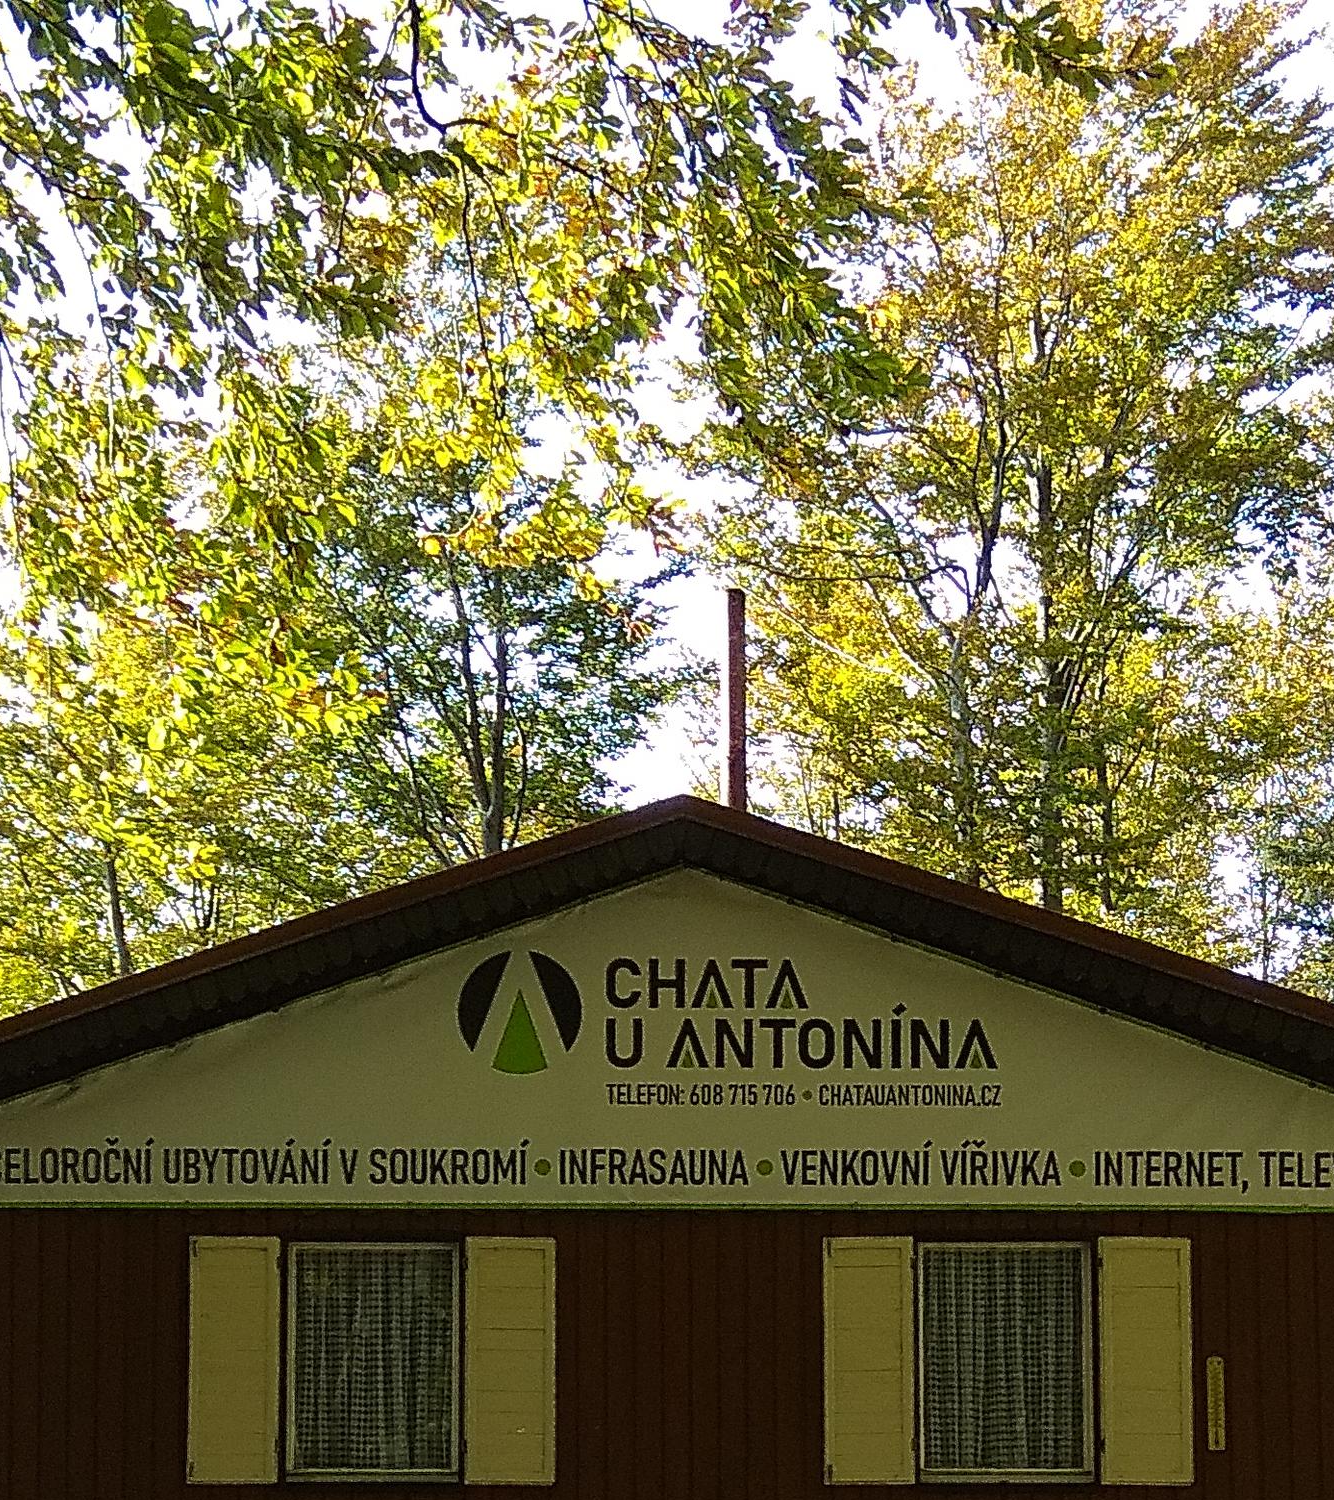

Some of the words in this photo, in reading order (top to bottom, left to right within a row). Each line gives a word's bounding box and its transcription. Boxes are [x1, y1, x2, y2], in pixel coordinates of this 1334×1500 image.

[604, 957, 809, 1010] CHATA
[604, 1017, 644, 1069] U
[665, 1002, 999, 1070] ANTONÍNA
[606, 1083, 685, 1106] TELEFON:
[689, 1083, 723, 1106] 608
[728, 1083, 758, 1106] 715
[763, 1083, 796, 1106] 706
[818, 1083, 1003, 1107] CHATAUANTONINA.CZ
[163, 1138, 333, 1185] UBYTOVÁNÍ
[339, 1148, 359, 1185] V
[368, 1138, 531, 1185] SOUKROMÍ
[558, 1147, 749, 1186] INFRASAUNA
[780, 1139, 934, 1187] VENKOVNÍ
[940, 1139, 1063, 1187] VÍŘIVKA
[1094, 1150, 1249, 1194] INTERNET,
